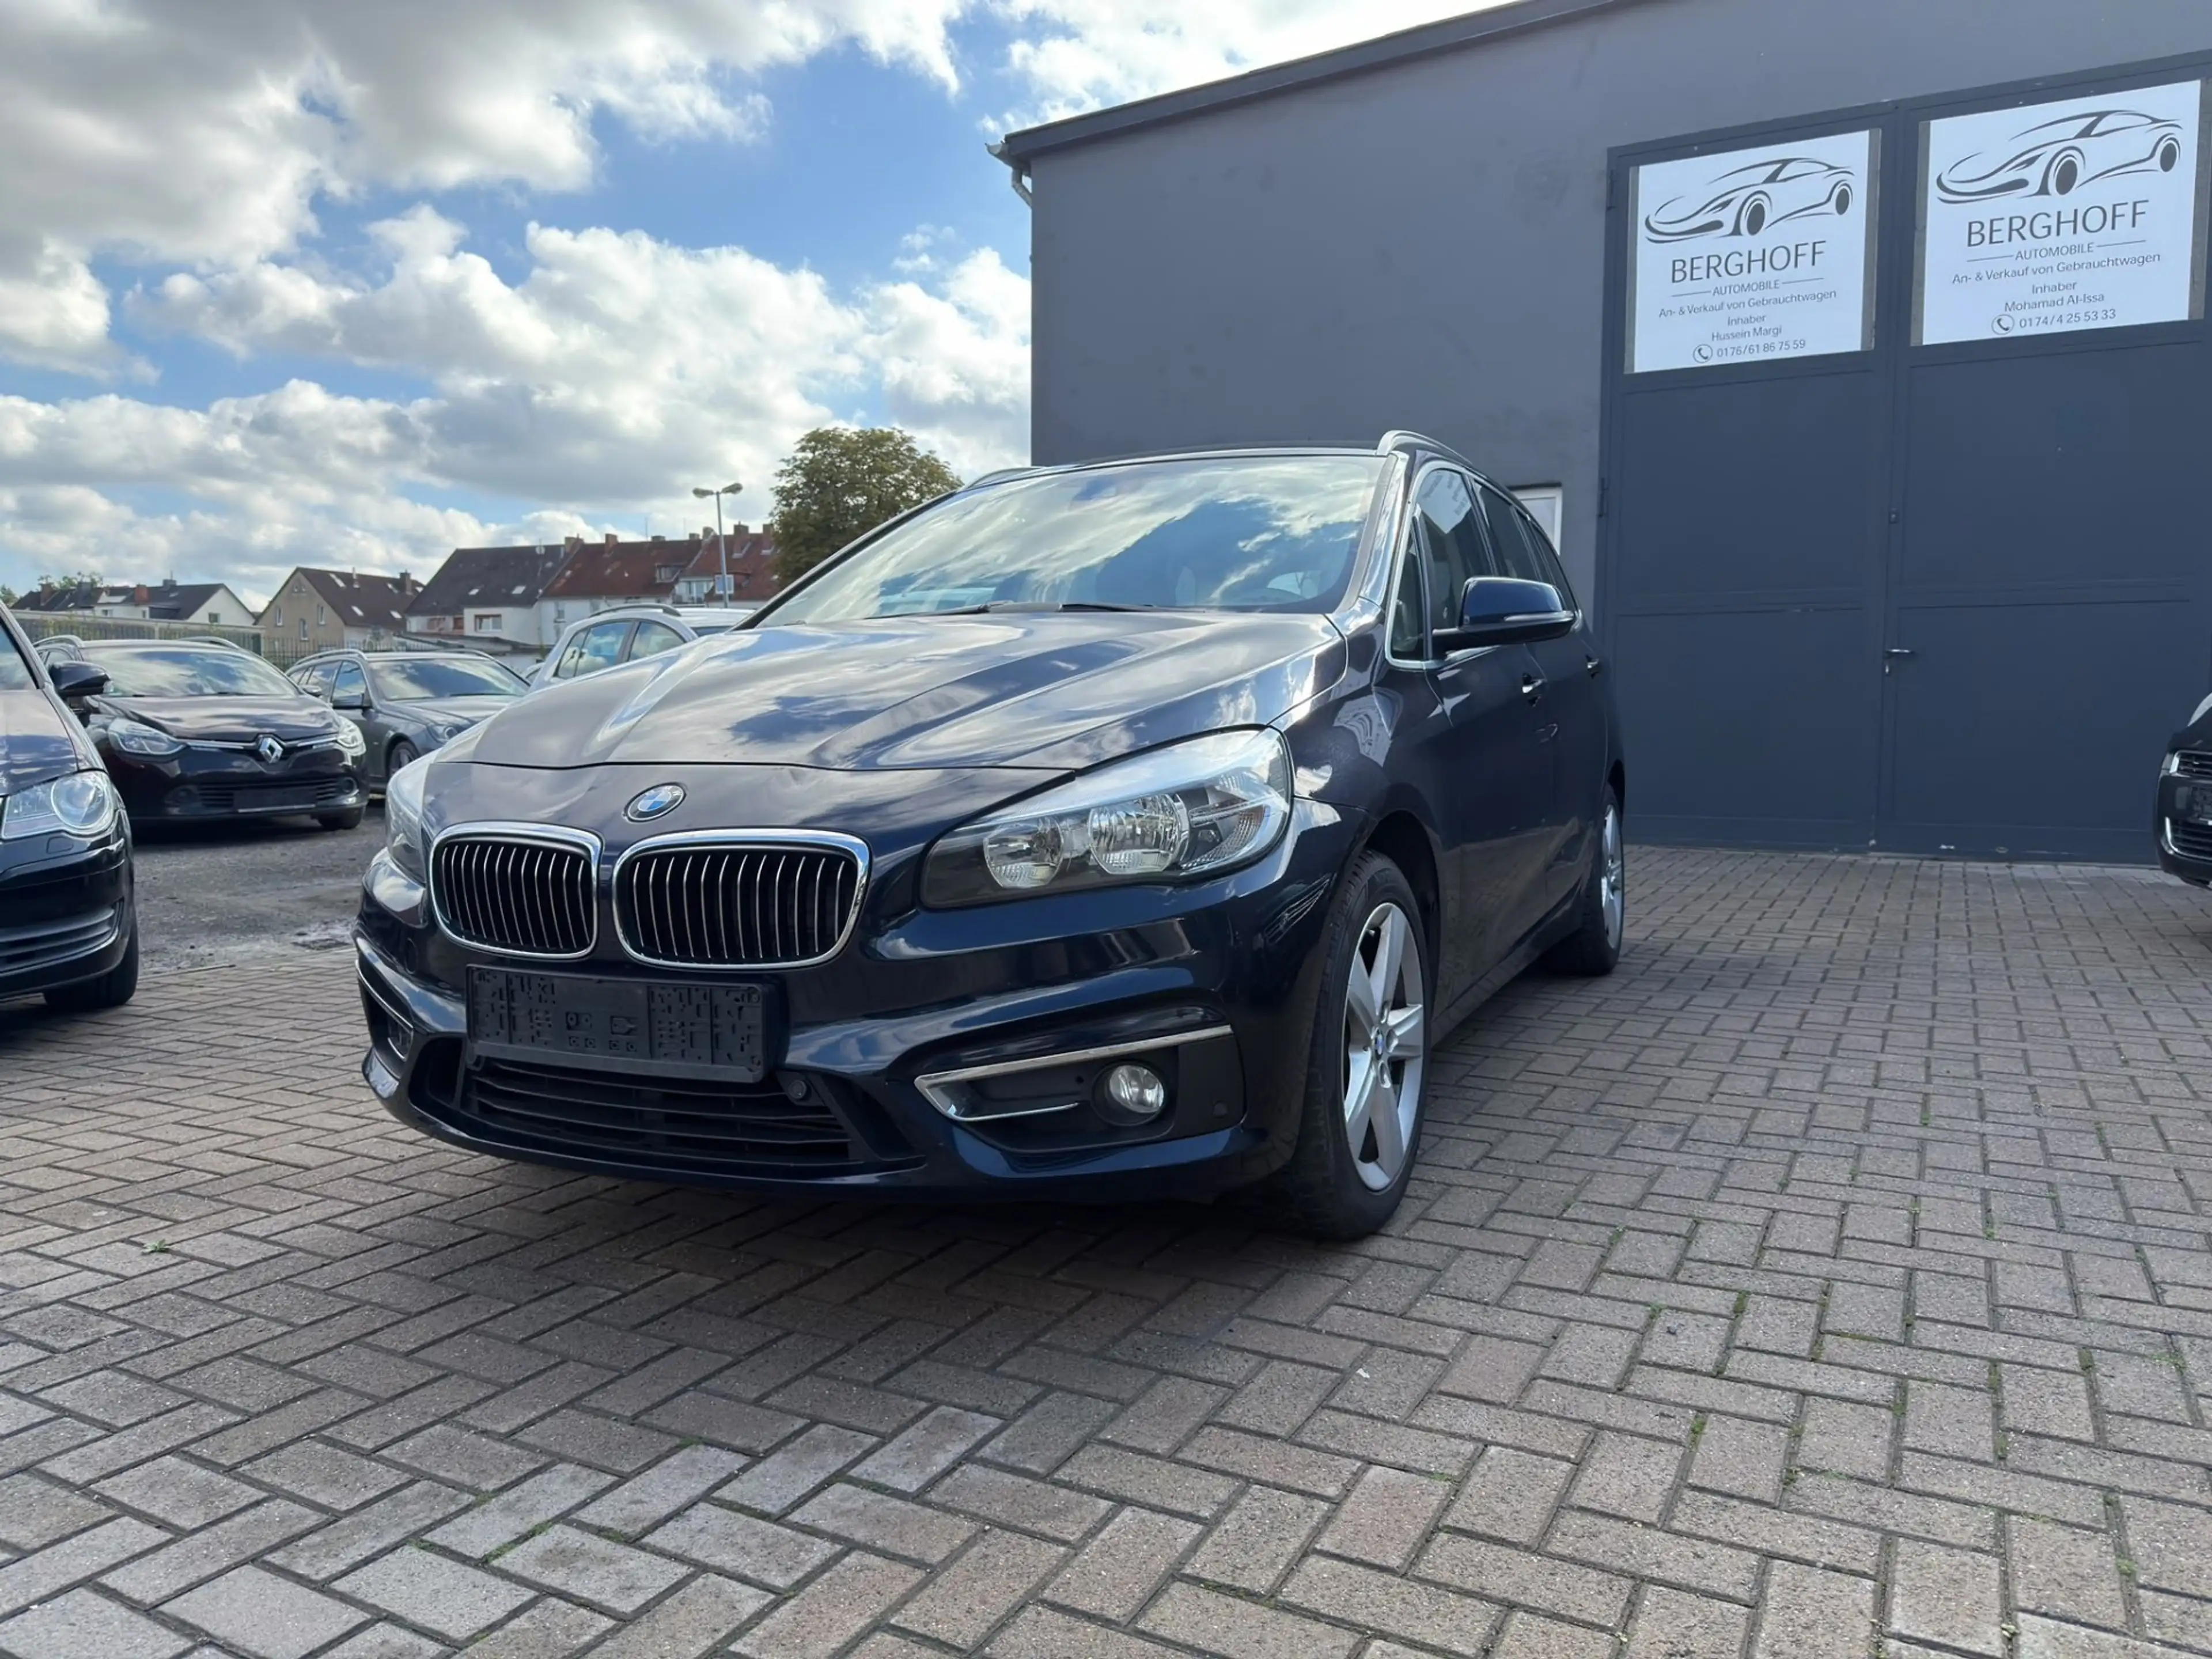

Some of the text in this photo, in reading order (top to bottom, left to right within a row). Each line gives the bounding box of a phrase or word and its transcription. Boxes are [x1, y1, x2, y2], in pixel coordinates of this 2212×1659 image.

[1967, 200, 2149, 247] BERGHOFF
[2015, 243, 2094, 261] AUTOMOBILE
[1671, 240, 1827, 283] BERGHOFF
[1952, 253, 2161, 284] An- & Verkauf von Gebrauchtwagen
[1712, 279, 1780, 296] AUTOMOBILE
[2032, 281, 2077, 294] Inhaber
[1658, 290, 1837, 318] An- & Verkauf von Gebrauchtwagen
[2004, 293, 2105, 312] Mohamad Al-Issa
[1728, 314, 1766, 326] Inhaber
[2066, 313, 2081, 323] 25
[2084, 310, 2099, 321] 53
[2101, 309, 2116, 319] 33
[1711, 325, 1782, 341] Hussein Margi
[1778, 340, 1791, 351] 75
[1792, 339, 1806, 349] 59
